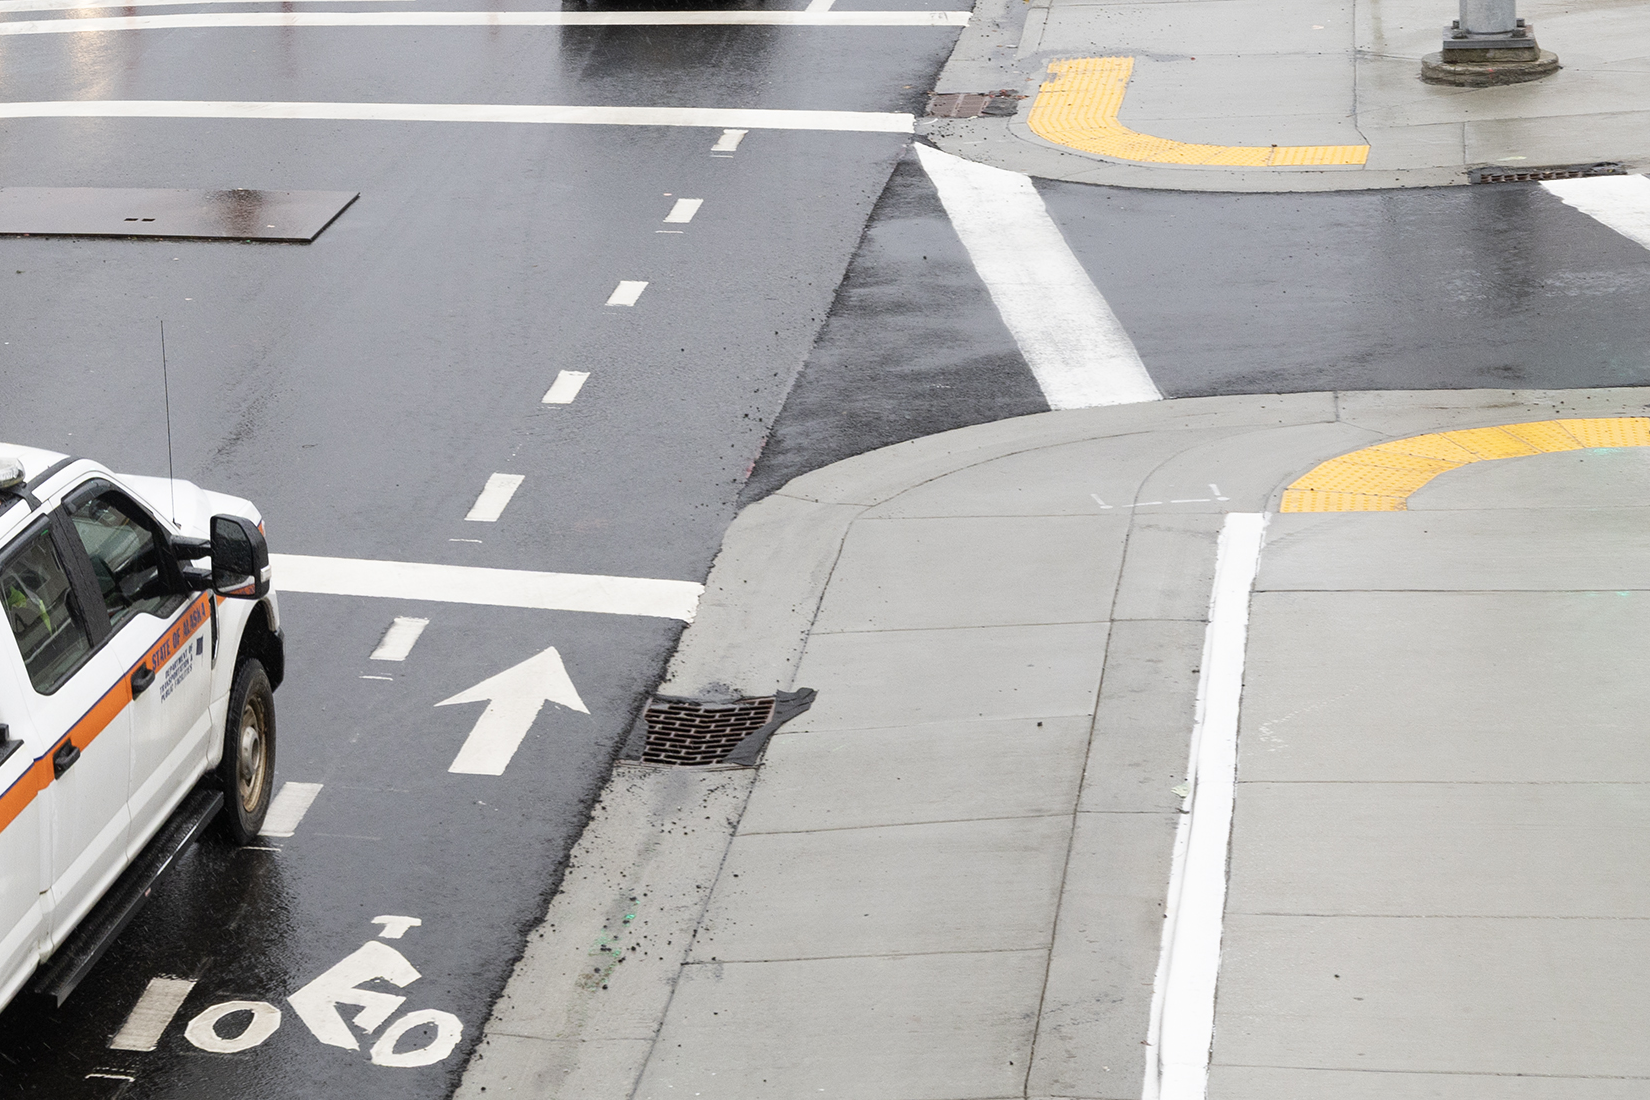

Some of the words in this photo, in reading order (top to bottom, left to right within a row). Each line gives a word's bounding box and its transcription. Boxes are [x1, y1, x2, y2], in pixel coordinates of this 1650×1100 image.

[151, 638, 171, 671] STATE
[172, 627, 181, 649] OF
[183, 602, 206, 638] ALASKA
